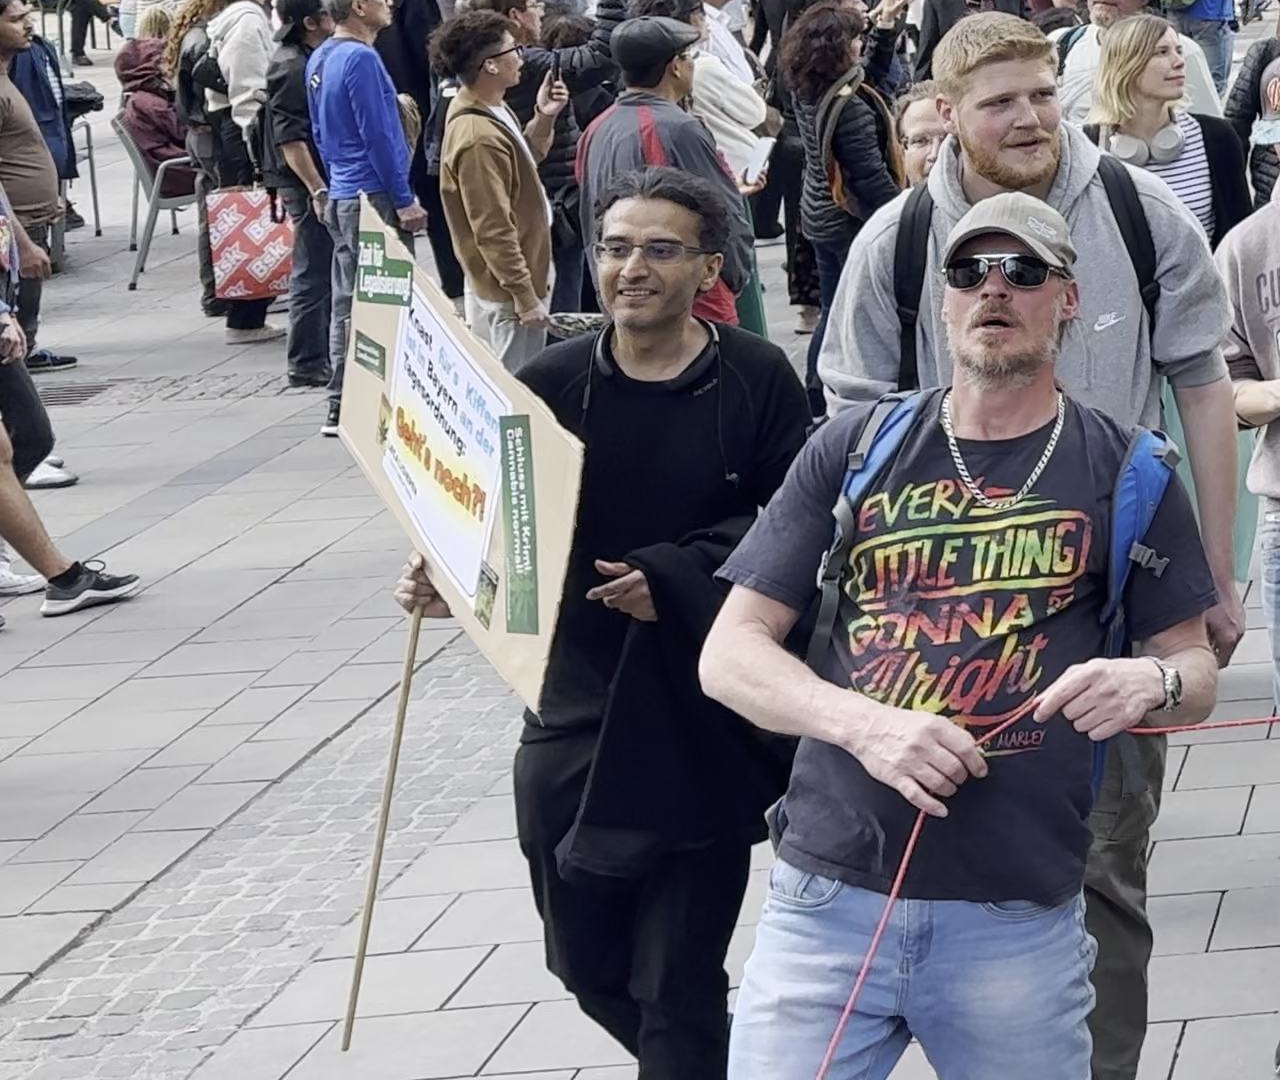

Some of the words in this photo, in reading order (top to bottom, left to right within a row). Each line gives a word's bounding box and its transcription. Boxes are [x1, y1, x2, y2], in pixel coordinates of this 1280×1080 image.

[403, 351, 467, 458] Tagesordnung:
[408, 308, 433, 352] Knast
[465, 381, 499, 435] Kiffen
[426, 358, 458, 417] Bayern
[474, 424, 496, 458] der
[857, 477, 984, 532] EVERY
[855, 535, 964, 603] LITTLE
[970, 521, 1077, 582] THING
[847, 592, 1035, 658] GONNA
[996, 729, 1047, 749] MARLEY
